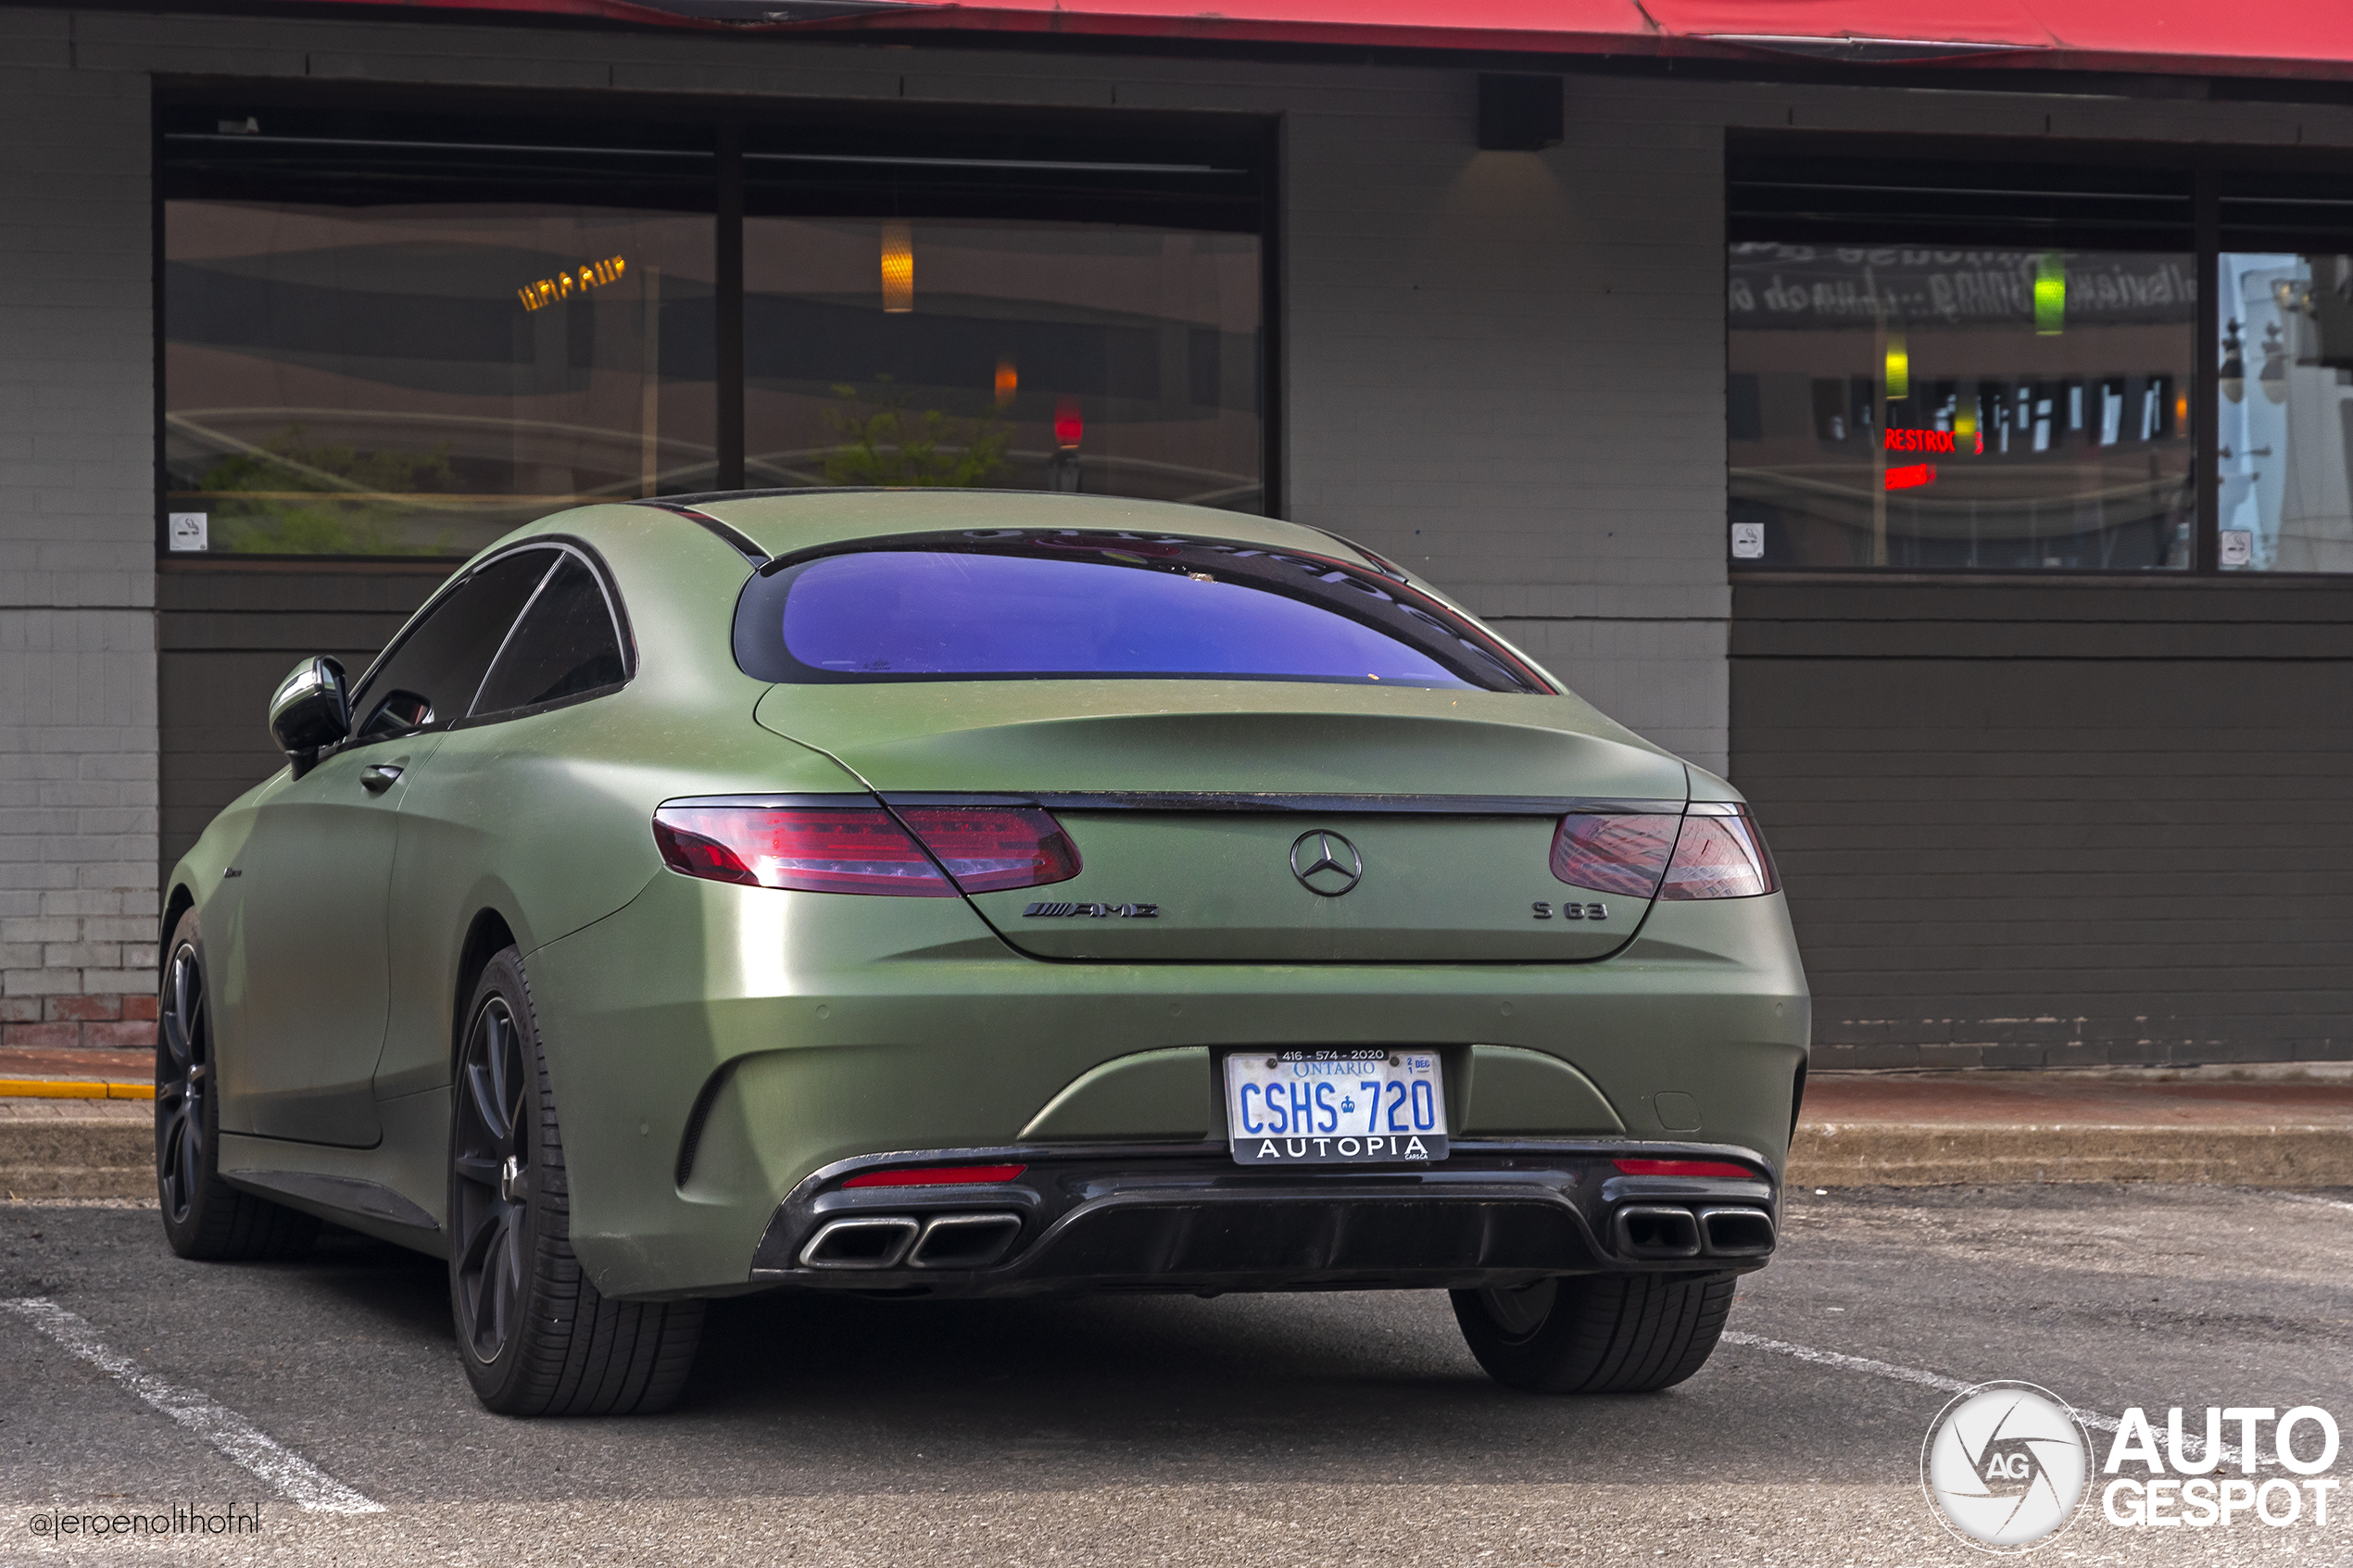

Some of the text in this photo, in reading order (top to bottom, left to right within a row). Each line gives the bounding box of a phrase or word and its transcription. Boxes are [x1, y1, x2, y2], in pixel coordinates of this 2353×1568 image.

[1065, 902, 1159, 917] AMG
[1531, 901, 1608, 920] S 63
[1282, 1051, 1303, 1061] 416
[1315, 1050, 1339, 1060] 574
[1351, 1049, 1385, 1060] 2020
[1415, 1060, 1430, 1068] DEC
[1293, 1060, 1376, 1078] ONTARIO
[1240, 1080, 1435, 1134] CSHS 720
[1256, 1135, 1428, 1159] AUTOPIA
